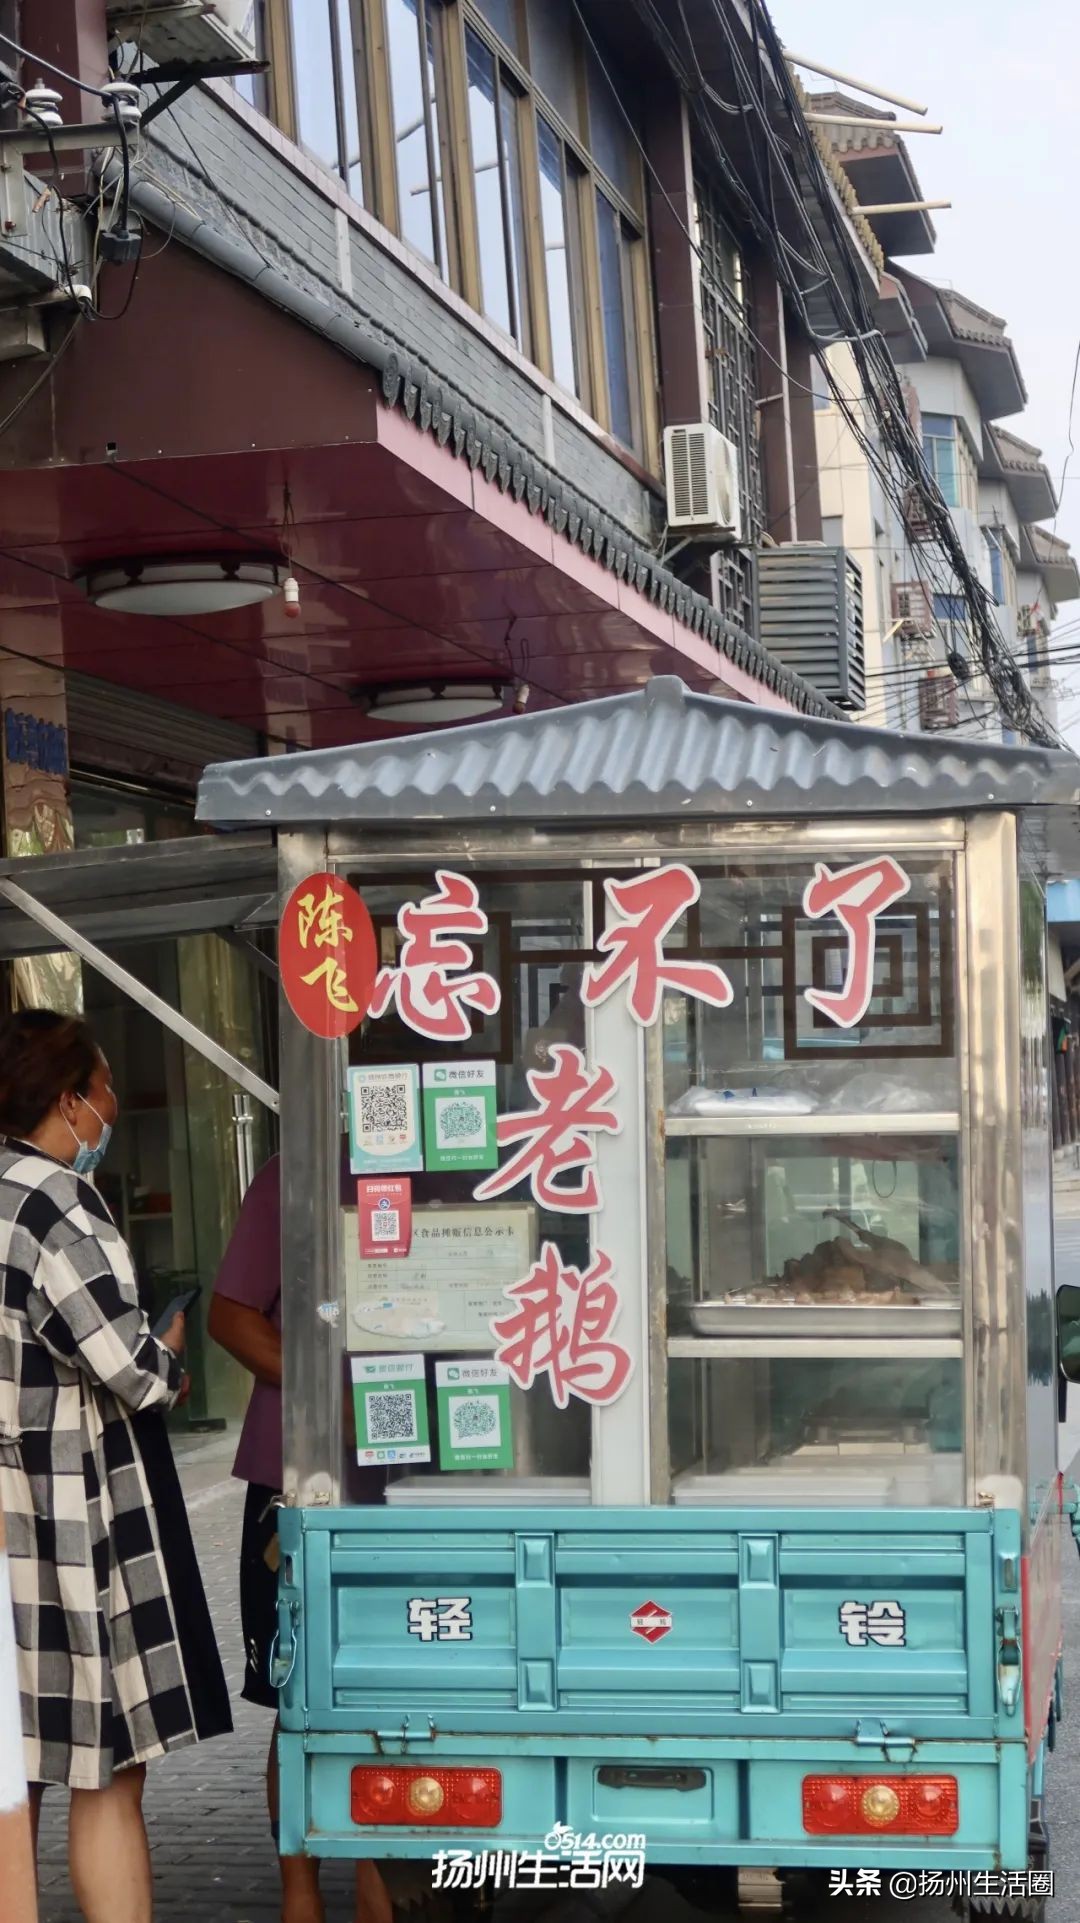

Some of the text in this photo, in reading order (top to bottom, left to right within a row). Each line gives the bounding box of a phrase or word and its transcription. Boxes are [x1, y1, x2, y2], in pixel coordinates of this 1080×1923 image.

[297, 884, 359, 1012] 陈飞
[367, 855, 912, 1040] 忘不了
[448, 1070, 485, 1079] 微信好友
[473, 1044, 636, 1408] 老鹅
[462, 1368, 498, 1378] 微信好友
[408, 1598, 906, 1646] 轻 铃
